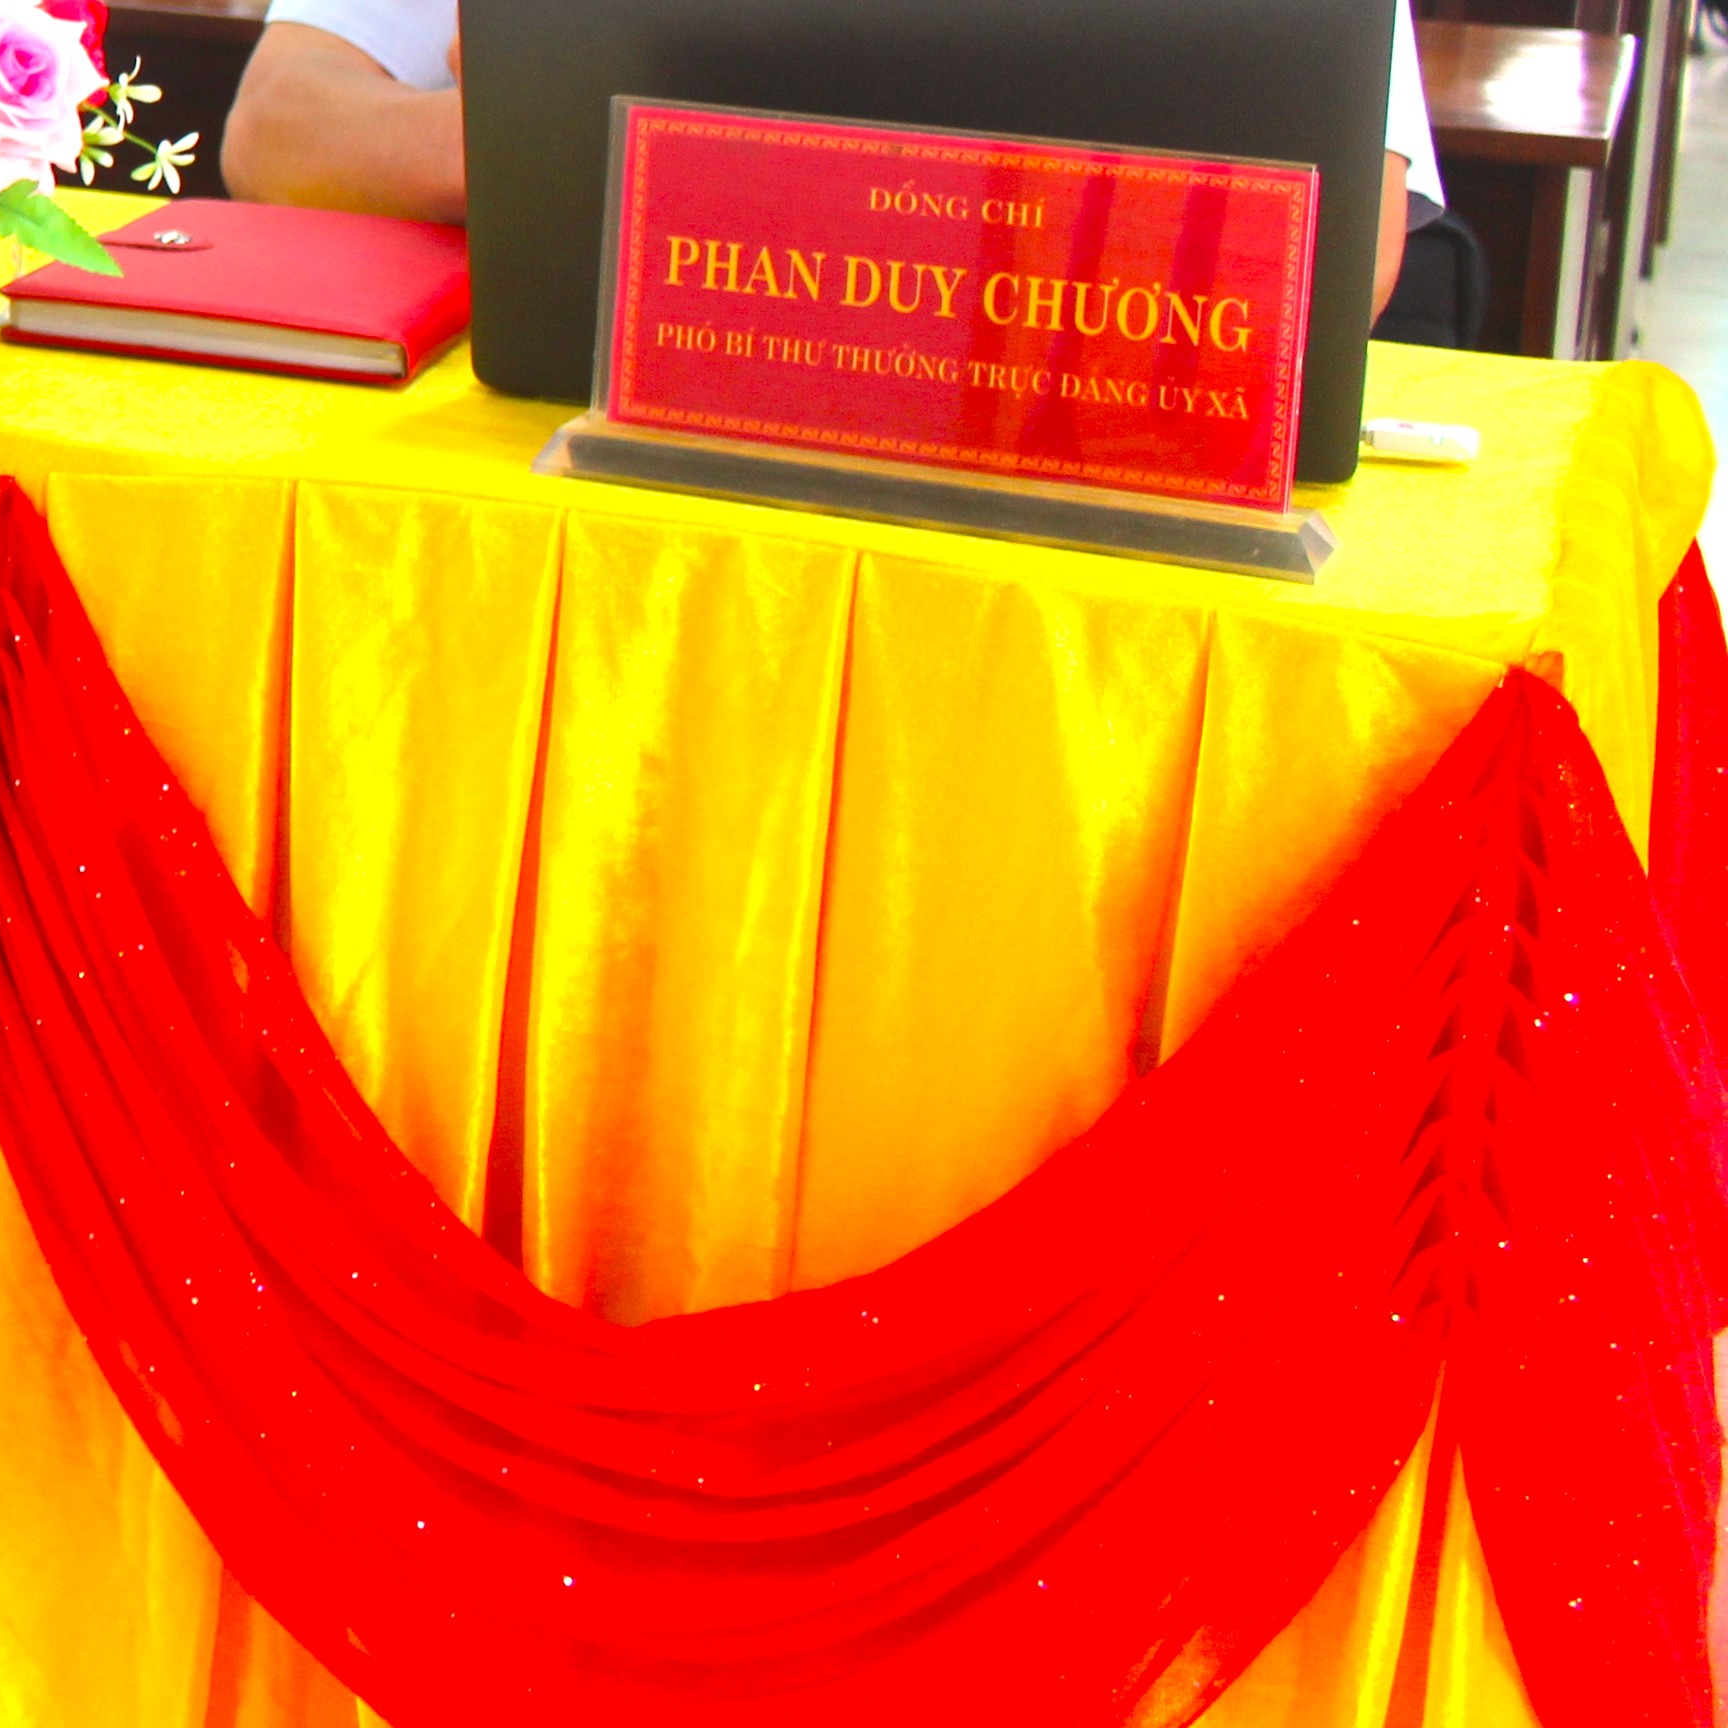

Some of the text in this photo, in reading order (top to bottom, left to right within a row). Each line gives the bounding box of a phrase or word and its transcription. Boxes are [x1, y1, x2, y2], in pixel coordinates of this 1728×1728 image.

[869, 178, 1045, 228] ĐỒNG CHÍ
[663, 234, 1252, 354] PHAN DUY CHƯƠNG
[656, 321, 717, 353] PHÓ
[725, 327, 756, 359] BÍ
[763, 335, 827, 368] THƯ
